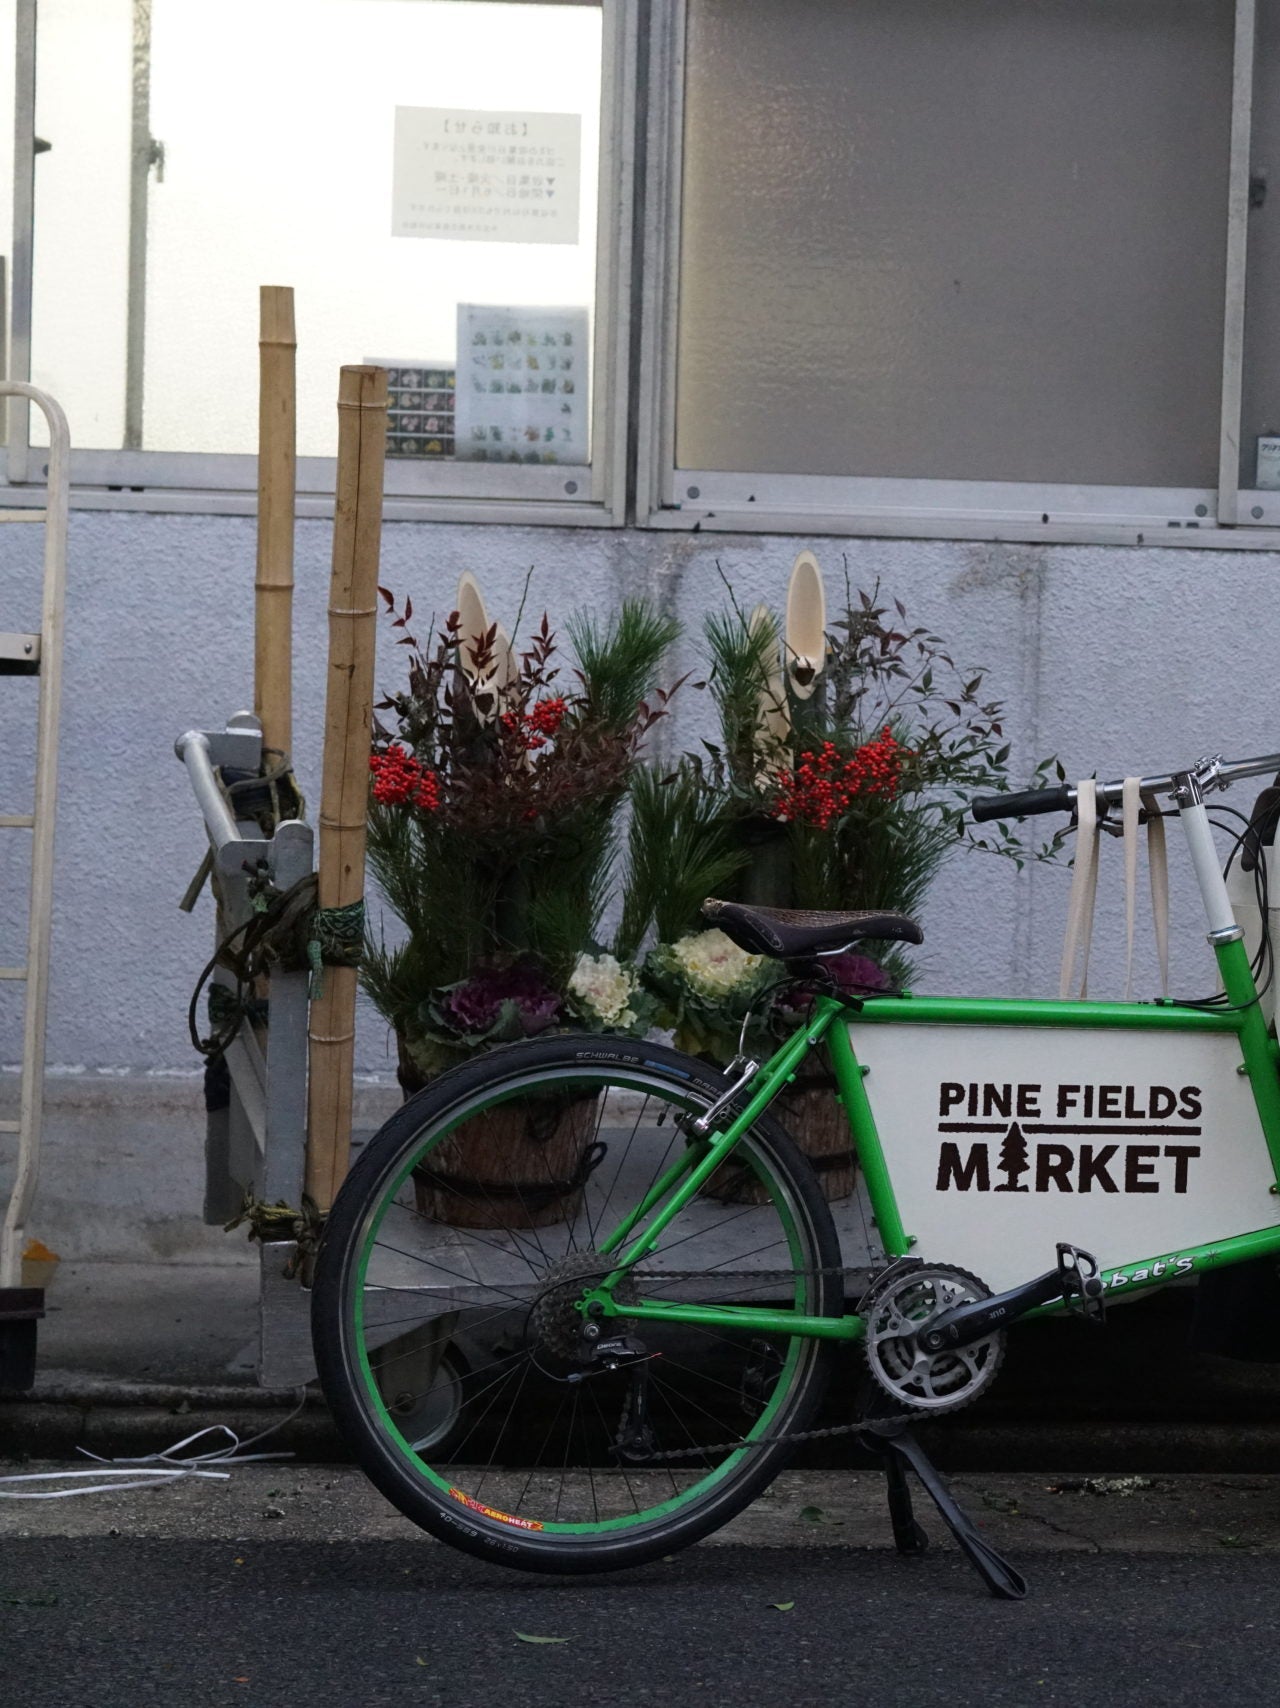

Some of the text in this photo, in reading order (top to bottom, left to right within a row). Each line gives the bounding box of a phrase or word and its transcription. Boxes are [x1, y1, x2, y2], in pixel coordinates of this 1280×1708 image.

[576, 1051, 640, 1064] SCHWALBE
[939, 1082, 1202, 1120] PINE FIELDS
